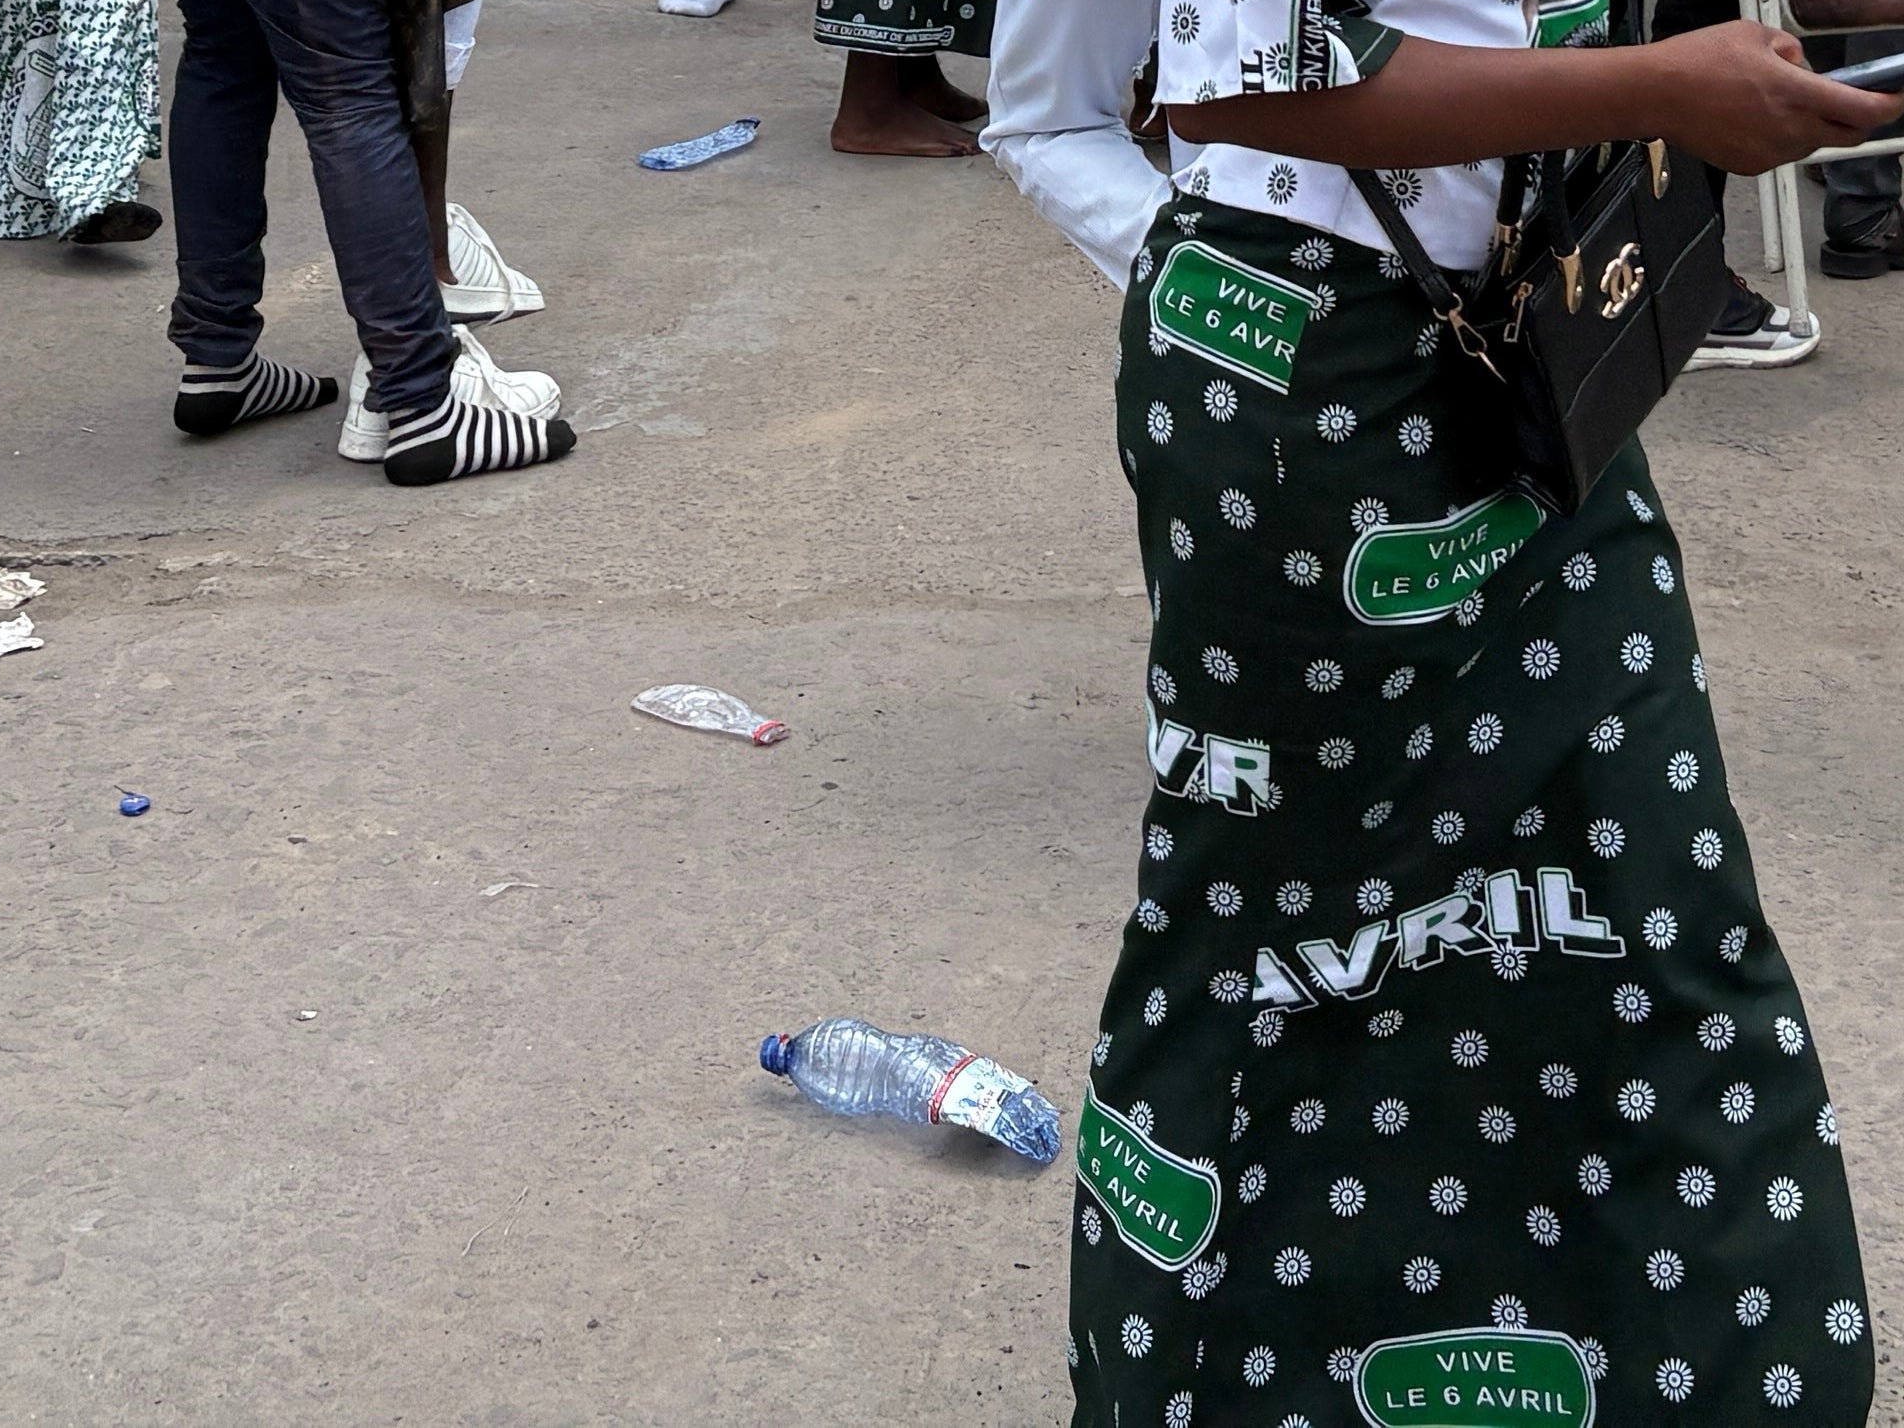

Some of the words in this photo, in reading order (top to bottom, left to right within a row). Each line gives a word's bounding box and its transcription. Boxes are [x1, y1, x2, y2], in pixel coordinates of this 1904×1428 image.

[1163, 285, 1199, 322] LE
[1205, 308, 1223, 331] 6
[1219, 277, 1287, 325] VIVE
[1429, 523, 1491, 562] VIVE
[1371, 575, 1411, 598] LE
[1425, 570, 1441, 591] 6
[1249, 865, 1627, 1030] AVRIL
[1097, 1125, 1154, 1188] VIVE
[1089, 1156, 1104, 1182] 6
[1102, 1175, 1185, 1247] AVRIL
[1435, 1350, 1517, 1378] VIVE
[1386, 1386, 1428, 1412] LE
[1442, 1384, 1464, 1408] 6
[1475, 1386, 1575, 1420] AVRIL
